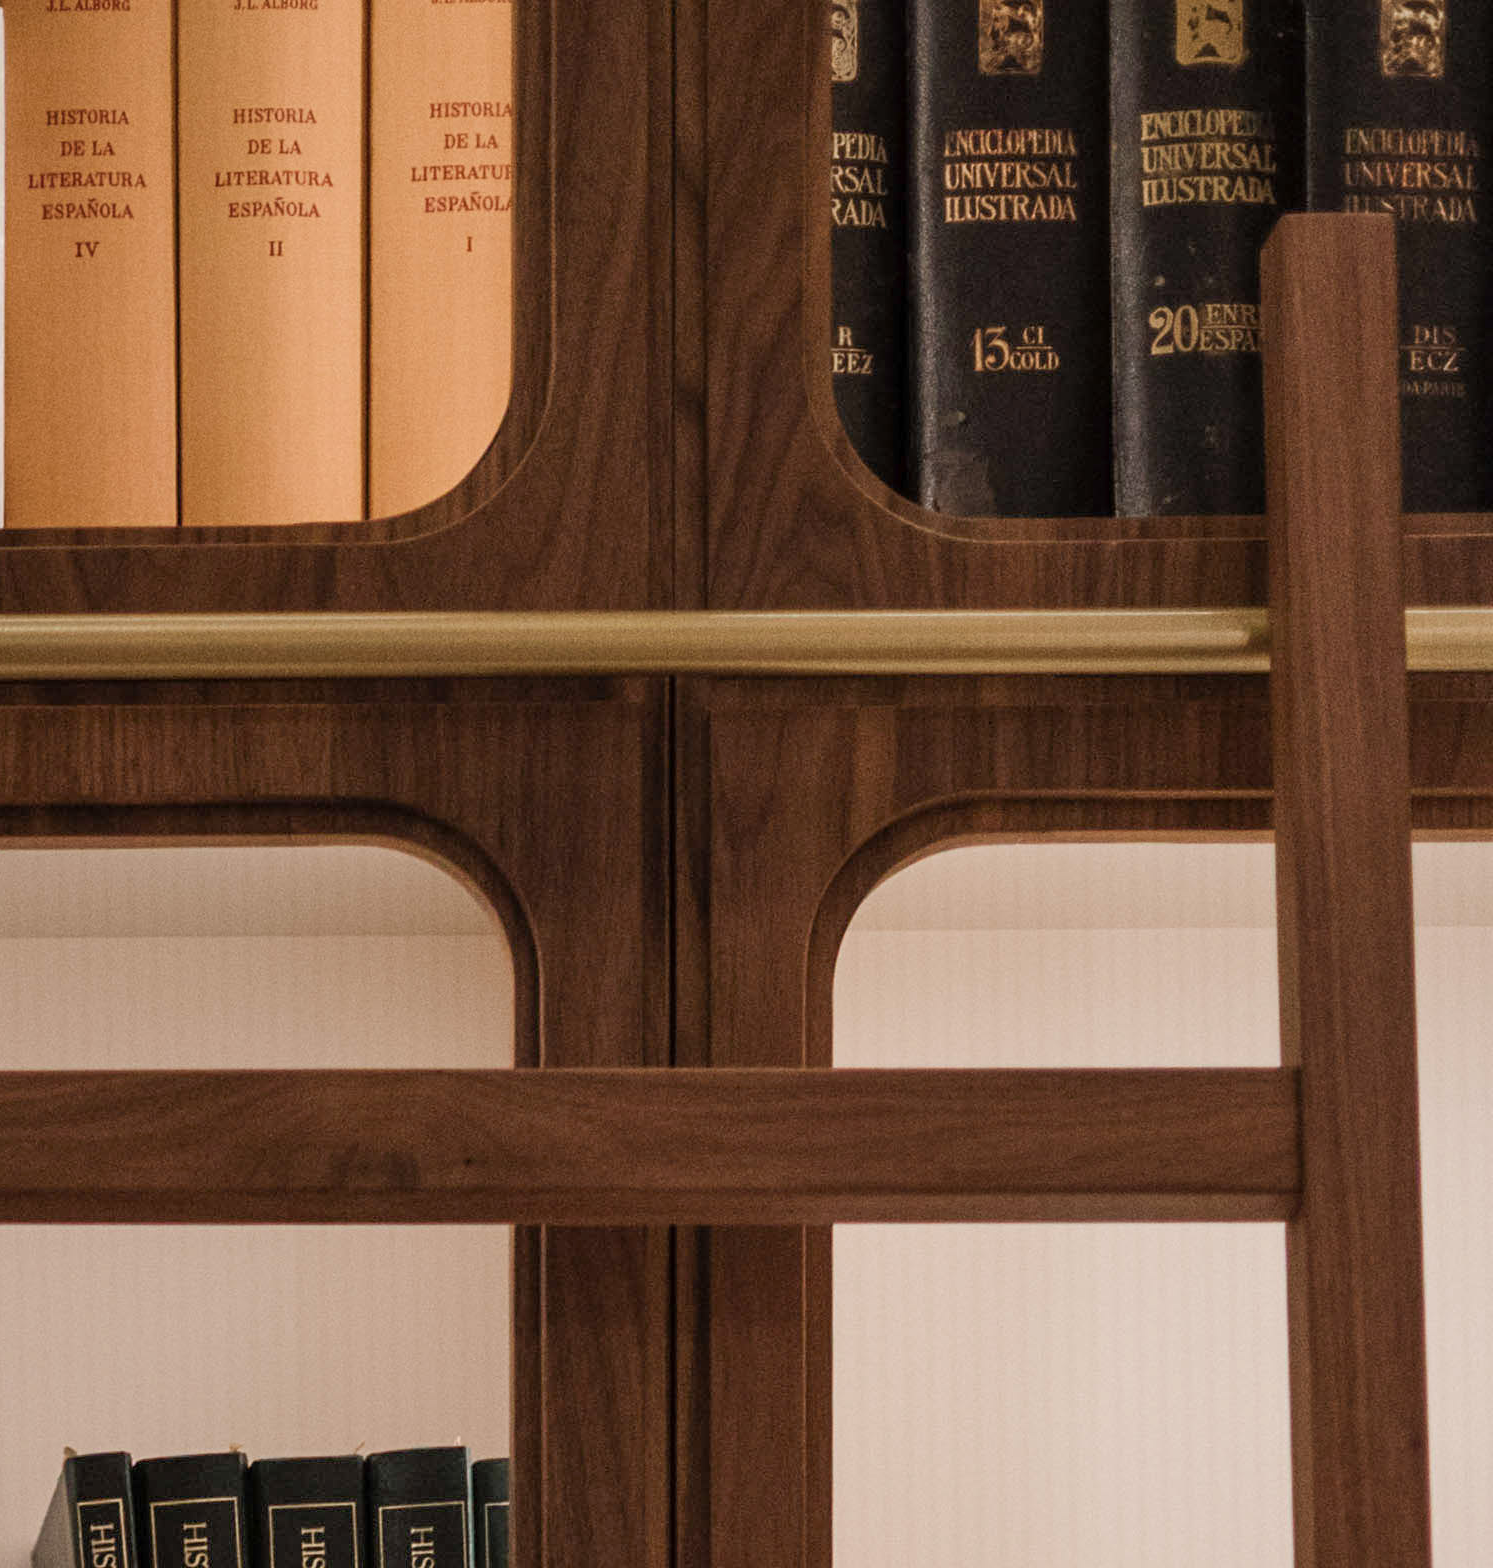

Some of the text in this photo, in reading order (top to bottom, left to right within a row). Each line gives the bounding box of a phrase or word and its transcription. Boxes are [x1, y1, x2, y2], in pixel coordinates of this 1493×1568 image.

[45, 109, 129, 125] HISTORIA
[233, 107, 317, 124] HISTORIA
[60, 141, 115, 156] DE LA
[247, 138, 301, 155] DE LA
[1141, 142, 1276, 173] UNIVERSAL
[27, 172, 147, 189] LITERATURA
[214, 171, 333, 188] LITERATURA
[944, 162, 1078, 191] UNIVERSAL
[1142, 176, 1276, 207] ILUSTRADA
[41, 199, 134, 219] ESPAÑOLA
[228, 197, 320, 218] ESPAÑOLA
[944, 195, 1077, 223] ILUSTRADA
[74, 241, 99, 259] IV
[268, 241, 283, 257] II
[1148, 305, 1199, 355] 20
[972, 326, 1010, 373] 13
[1011, 350, 1059, 372] COLD
